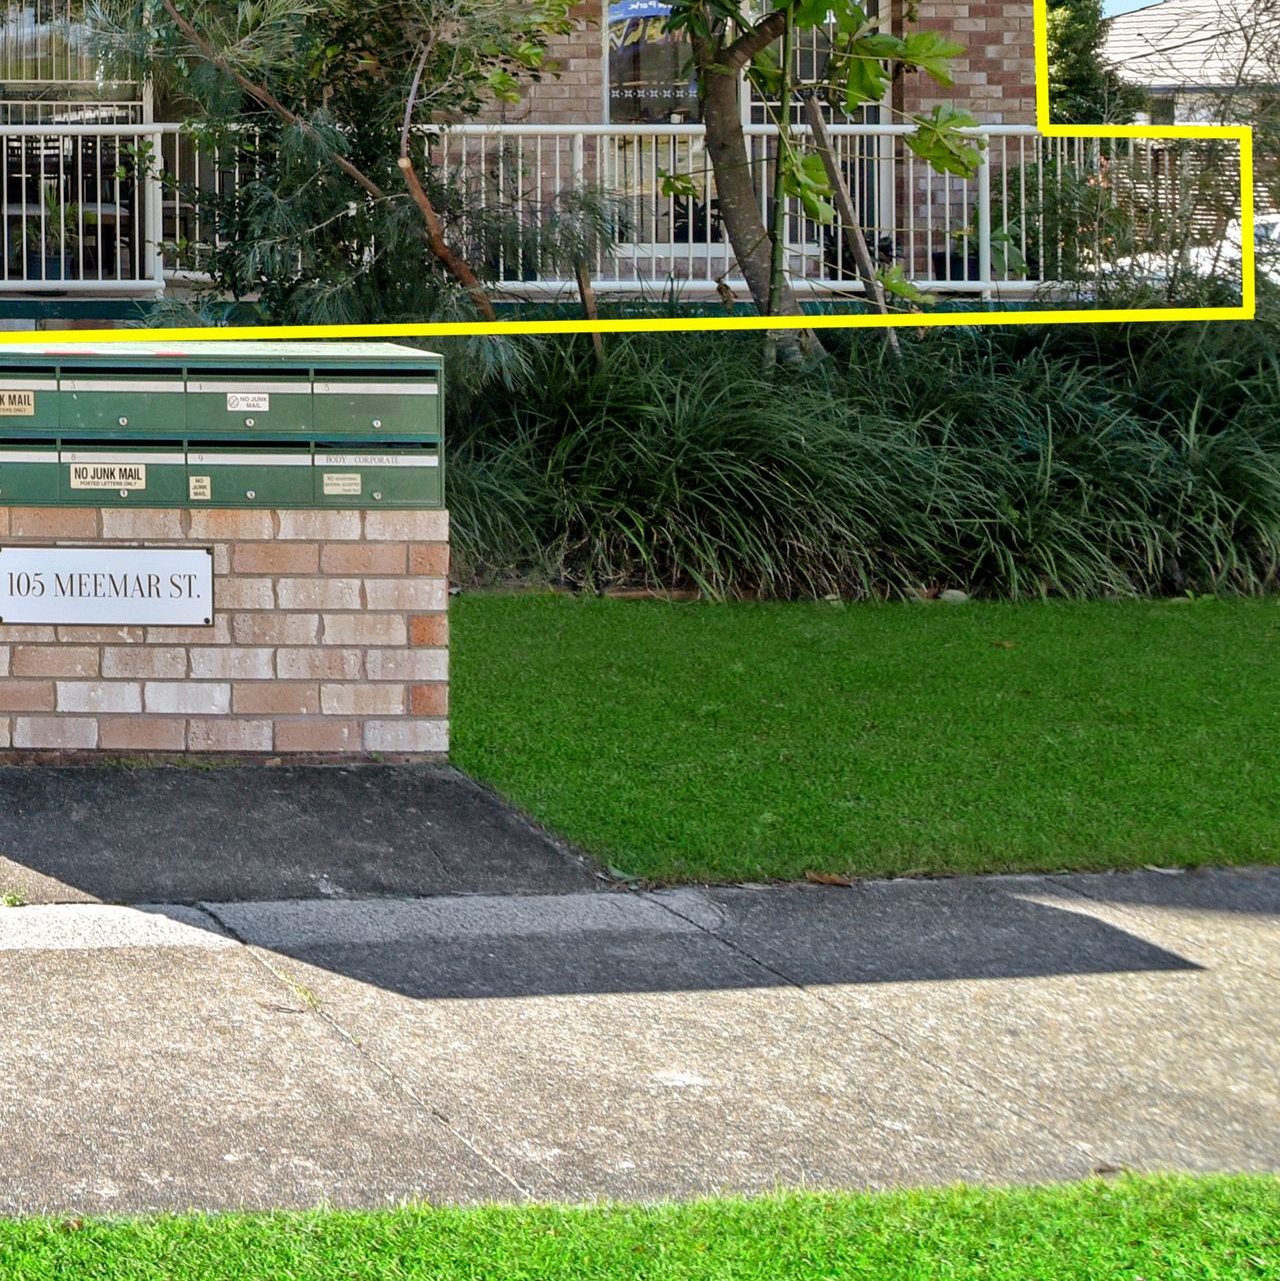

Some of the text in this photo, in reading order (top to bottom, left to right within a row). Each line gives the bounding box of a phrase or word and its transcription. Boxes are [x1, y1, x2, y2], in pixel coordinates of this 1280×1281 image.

[8, 394, 32, 407] MAIL
[325, 455, 400, 464] BODY CORPORATE
[74, 466, 143, 481] NO JUNK MAIL
[7, 571, 201, 599] 105 MEEMAR ST.
